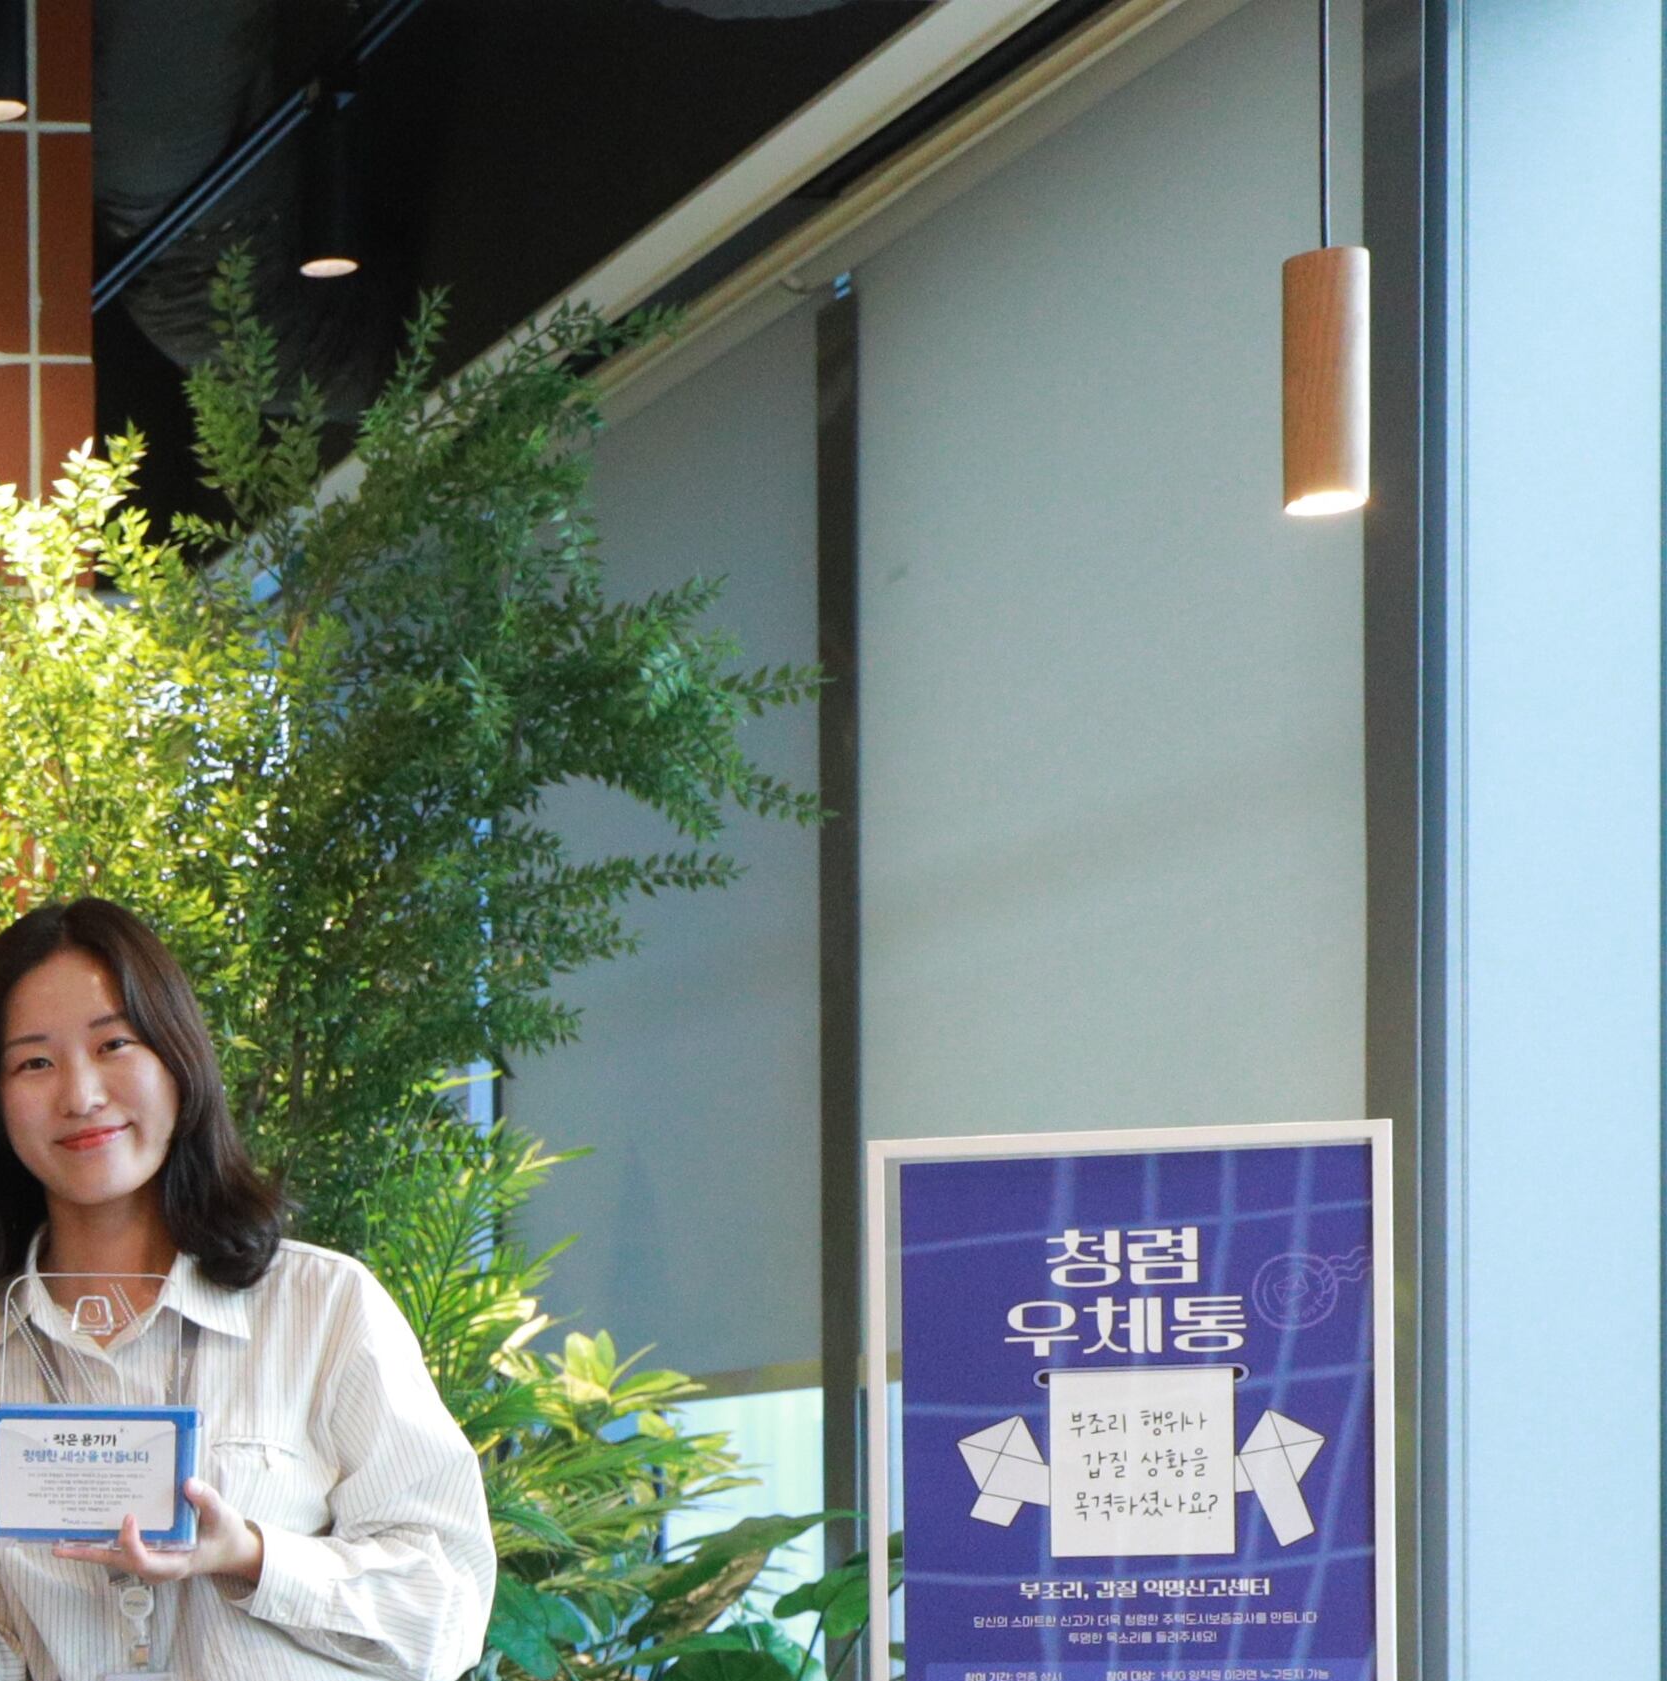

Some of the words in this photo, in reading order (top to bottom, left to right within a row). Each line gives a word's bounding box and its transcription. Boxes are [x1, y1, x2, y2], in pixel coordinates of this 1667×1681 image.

[1046, 1227, 1198, 1288] 청렴
[1004, 1296, 1247, 1357] 우체통
[1070, 1411, 1127, 1437] 부조리
[1140, 1410, 1208, 1437] 행위나
[52, 1433, 78, 1446] 작은
[81, 1433, 117, 1447] 용기가
[60, 1449, 99, 1463] 세상을
[101, 1450, 150, 1464] 만듭니다
[1083, 1451, 1127, 1479] 갑질
[1141, 1448, 1208, 1478] 상황을
[1074, 1490, 1218, 1521] 목격하셨나요?
[1019, 1581, 1089, 1601] 부조리,
[1096, 1580, 1138, 1599] 갑질
[1143, 1578, 1271, 1598] 익명신고센터
[973, 1615, 1009, 1629] 당신의
[1011, 1615, 1056, 1628] 스마트한
[1060, 1614, 1094, 1627] 신고가
[1097, 1614, 1121, 1627] 더욱
[1270, 1611, 1317, 1625] 만듭니다
[1068, 1632, 1102, 1644] 투명한
